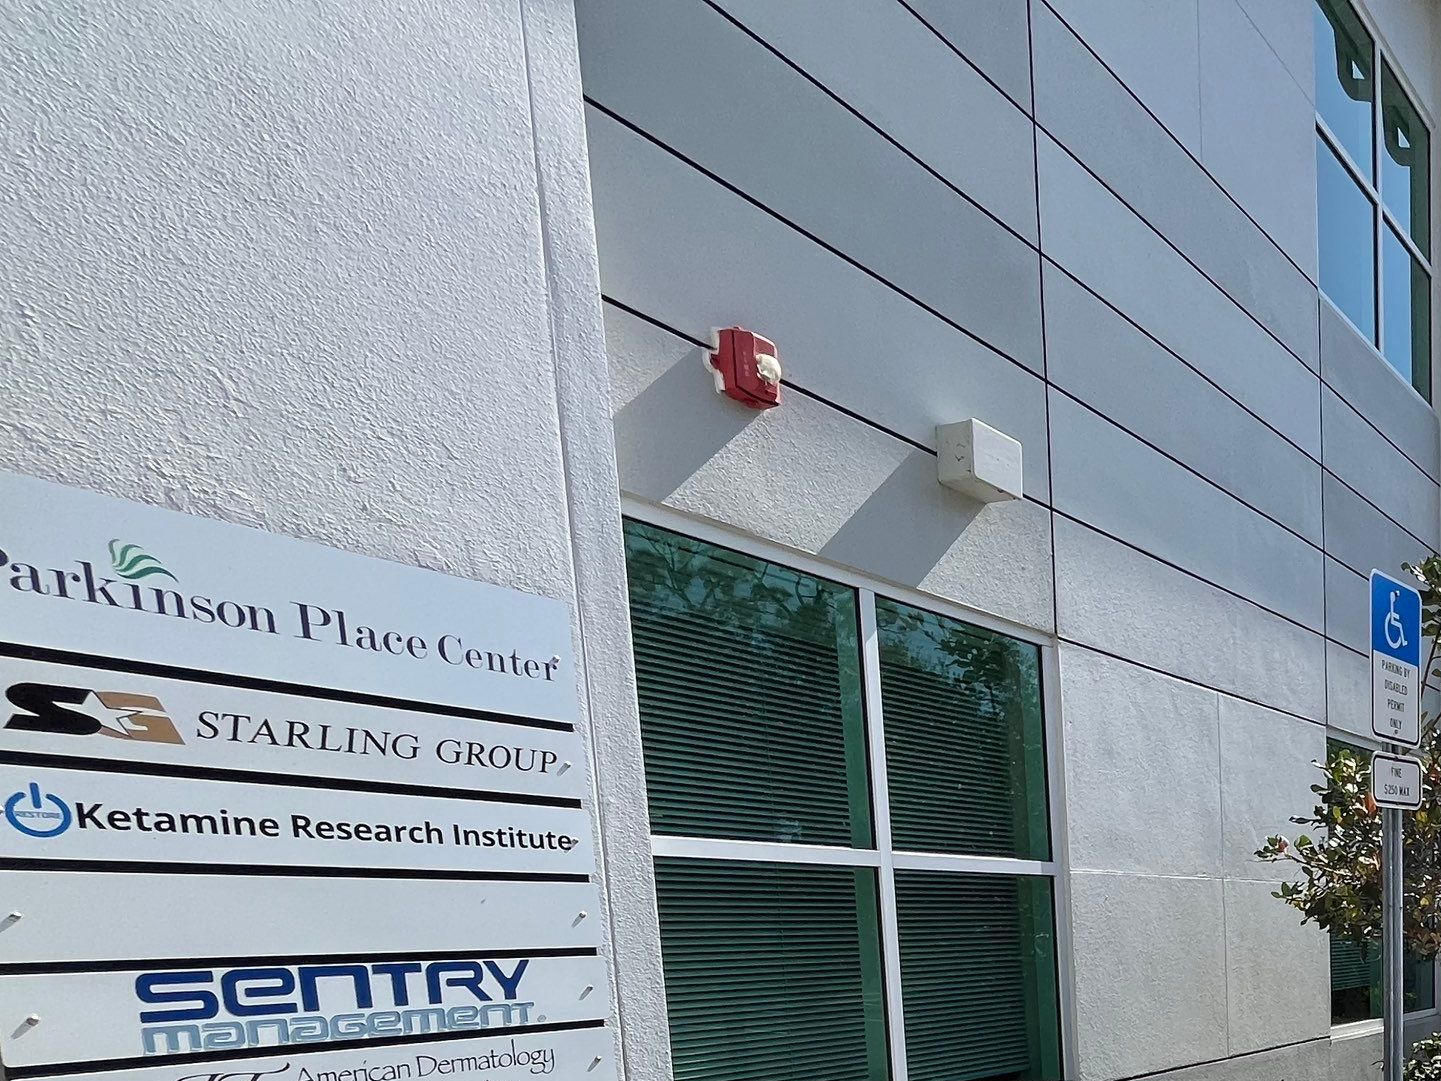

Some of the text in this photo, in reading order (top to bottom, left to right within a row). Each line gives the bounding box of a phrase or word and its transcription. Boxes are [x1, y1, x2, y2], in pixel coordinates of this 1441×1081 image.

[0, 548, 559, 682] arkinson Place Center
[1384, 679, 1408, 695] DISABLED
[196, 710, 558, 774] STARLING GROUP
[75, 801, 573, 851] Ketamine Research Institute
[416, 1039, 556, 1076] Dermatology
